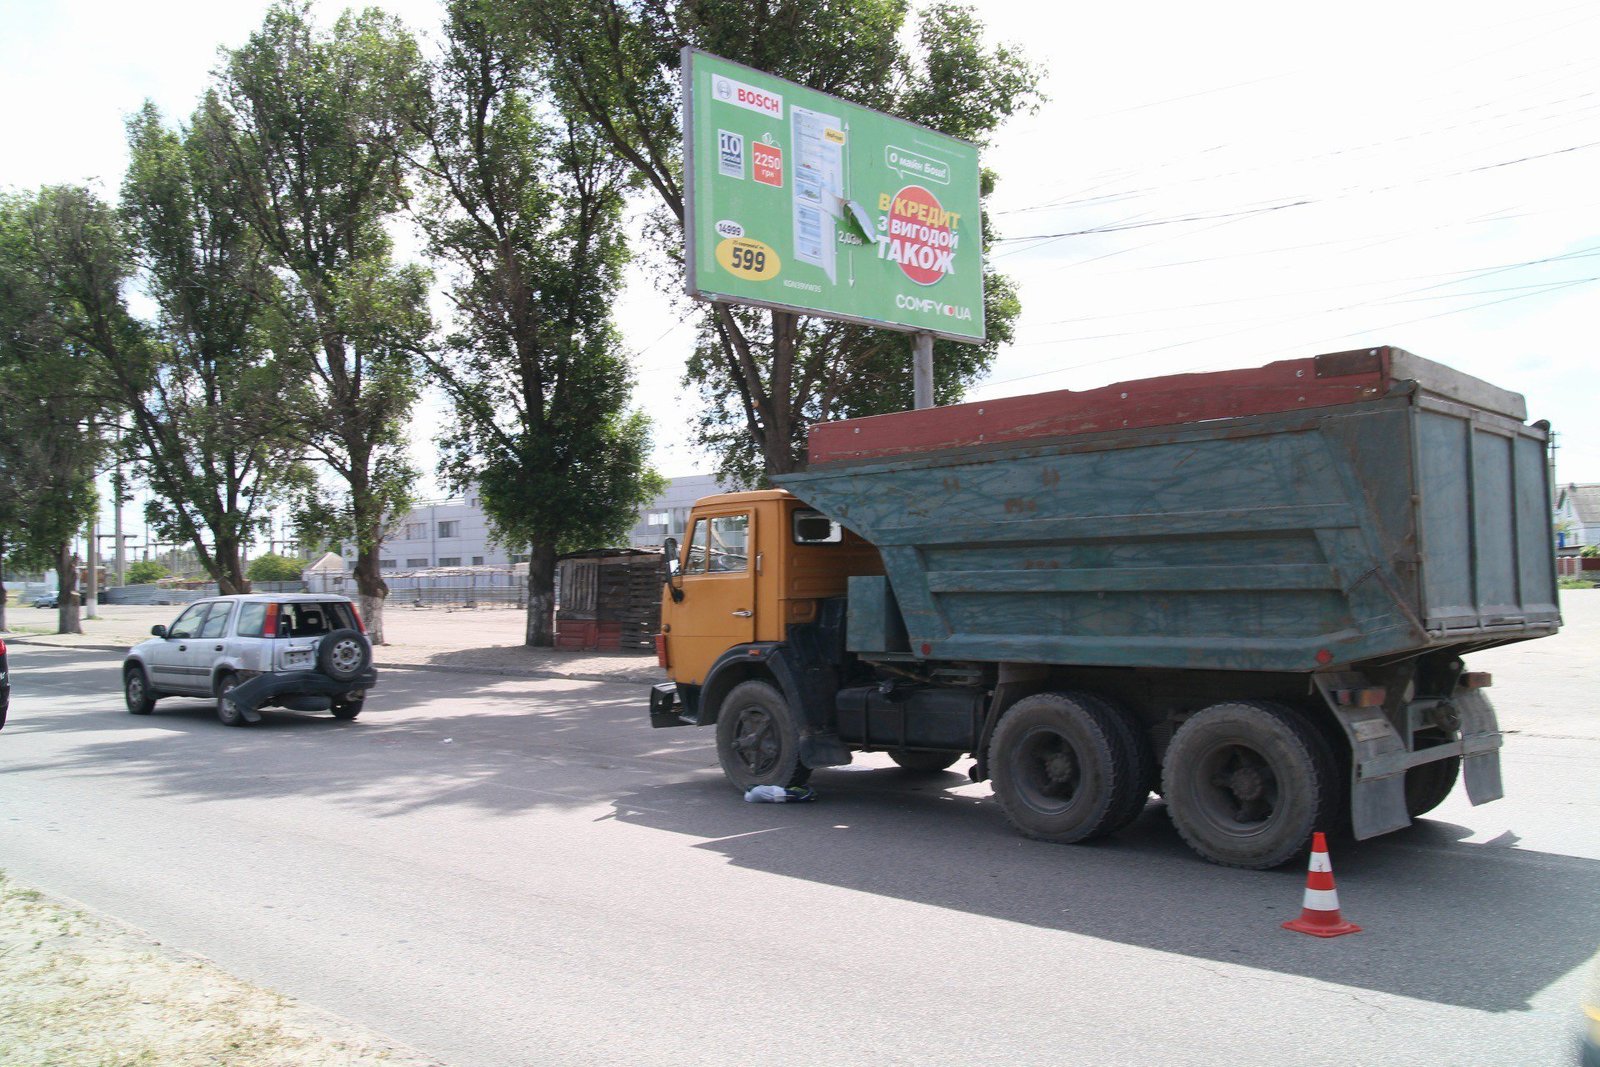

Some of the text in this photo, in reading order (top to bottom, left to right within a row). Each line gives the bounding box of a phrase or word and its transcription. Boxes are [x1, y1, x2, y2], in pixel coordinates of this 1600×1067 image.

[737, 88, 780, 113] BOSCH
[721, 133, 742, 155] 10
[754, 152, 780, 170] 2250
[878, 193, 961, 230] В КРЕДИТ
[891, 219, 960, 250] ВИГОДОЙ
[731, 246, 766, 273] 599
[876, 234, 956, 275] ТАКОЖ
